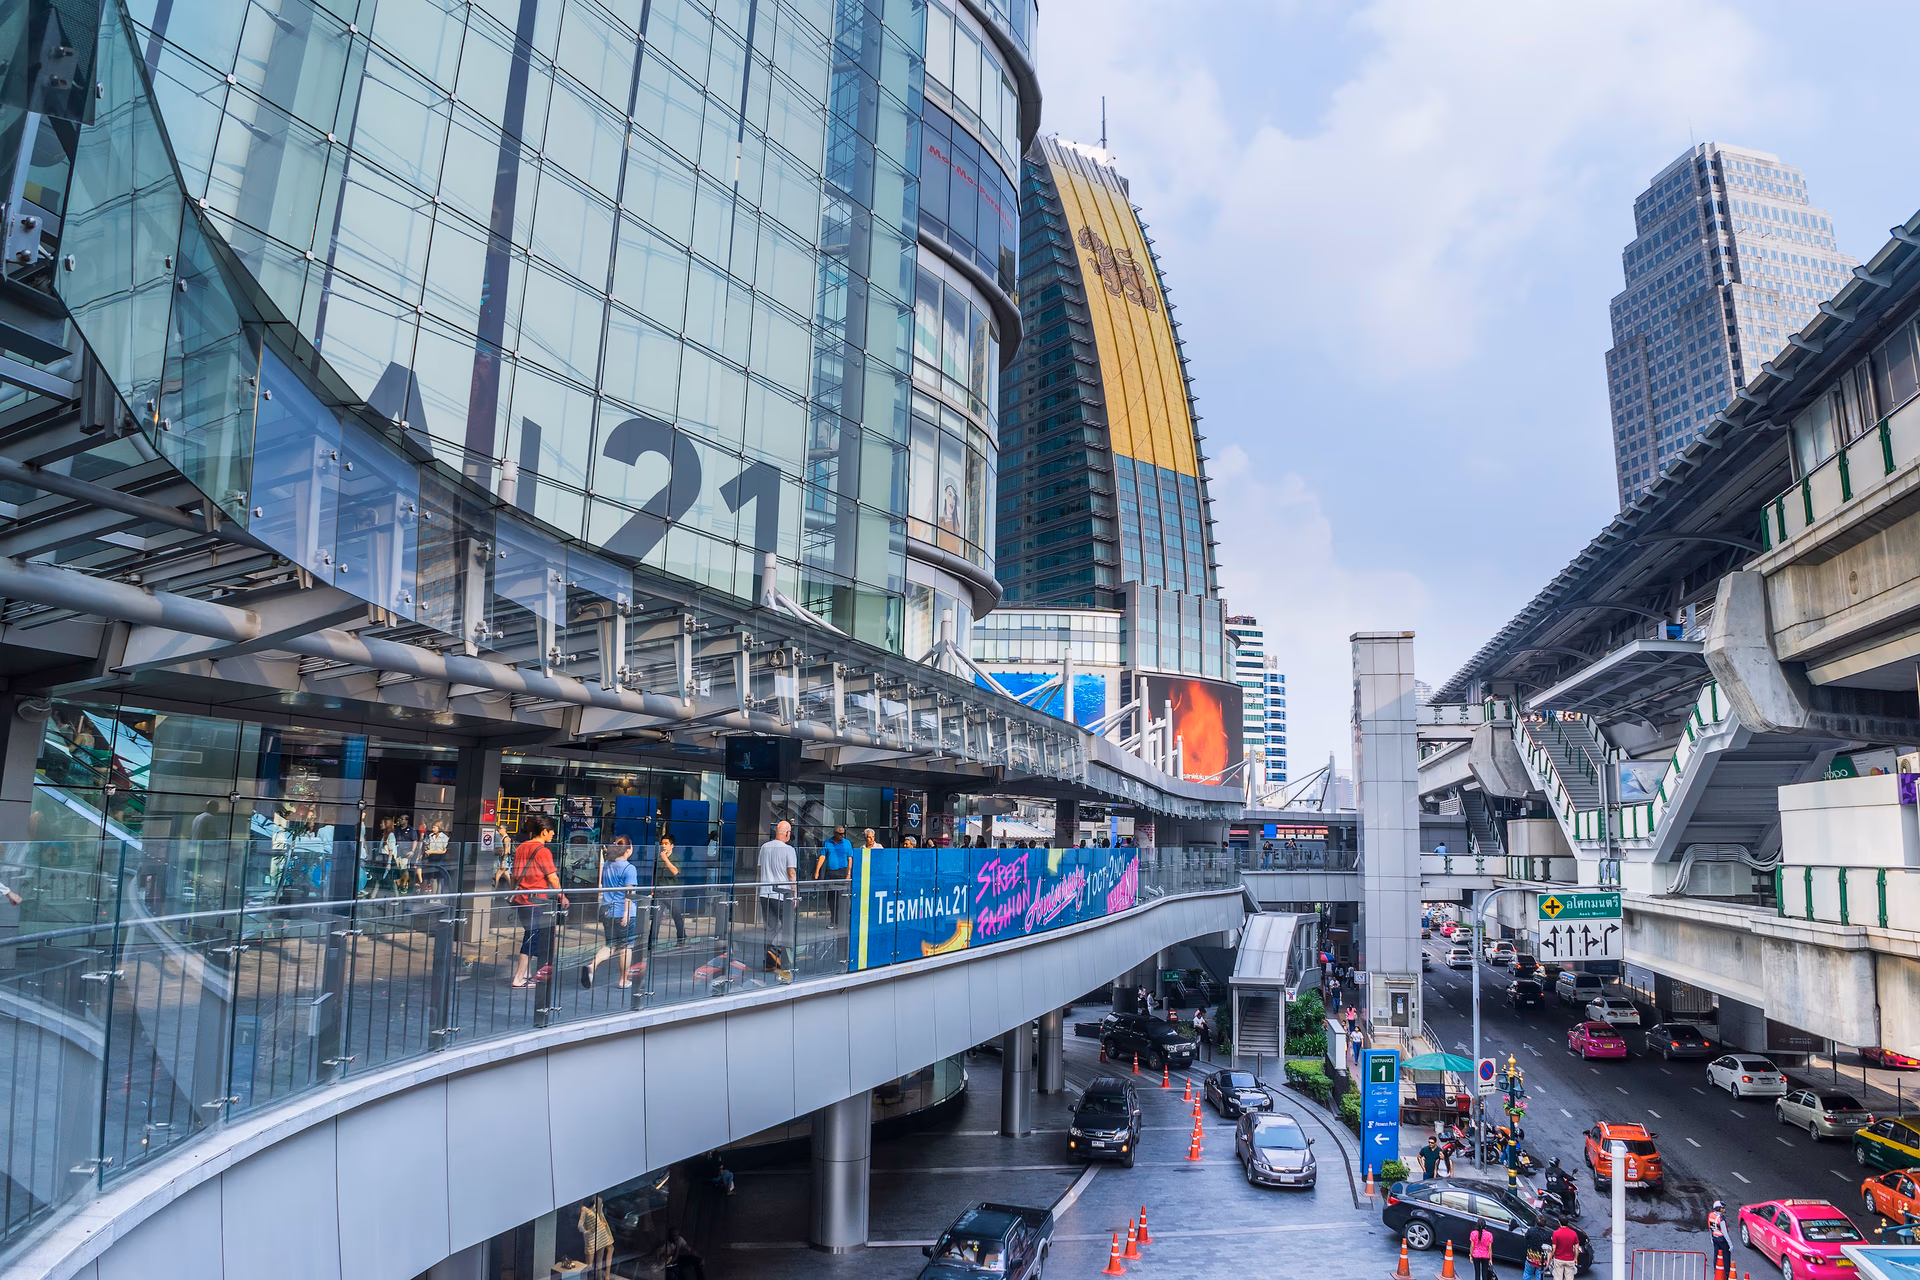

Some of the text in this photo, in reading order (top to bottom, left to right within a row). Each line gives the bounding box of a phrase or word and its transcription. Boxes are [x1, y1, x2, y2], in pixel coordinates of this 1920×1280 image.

[599, 418, 781, 605] 21
[953, 886, 968, 915] 21
[976, 852, 1029, 904] STREET
[1025, 864, 1086, 933] Anniversary
[1566, 894, 1619, 909] อโศกมนตรี
[977, 881, 1031, 939] FASHION
[1378, 1065, 1386, 1081] 1
